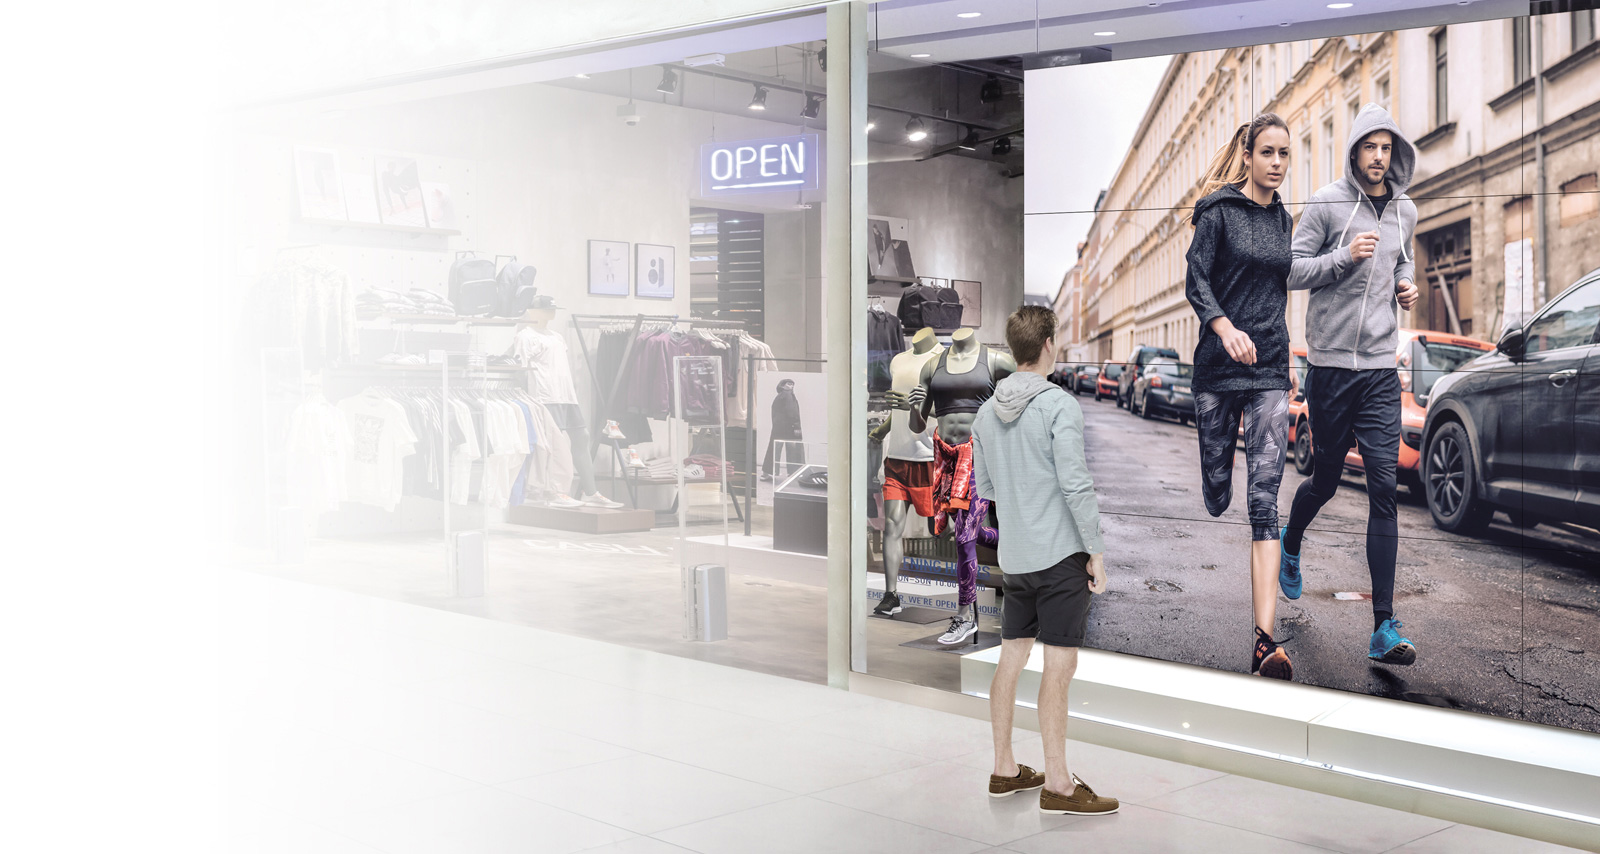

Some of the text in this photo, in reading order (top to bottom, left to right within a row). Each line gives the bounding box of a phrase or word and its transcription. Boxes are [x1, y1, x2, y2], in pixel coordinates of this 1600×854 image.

[711, 141, 804, 180] OPEN
[903, 556, 941, 573] ENING
[897, 574, 931, 585] ON-SUN
[935, 599, 957, 609] OPEN
